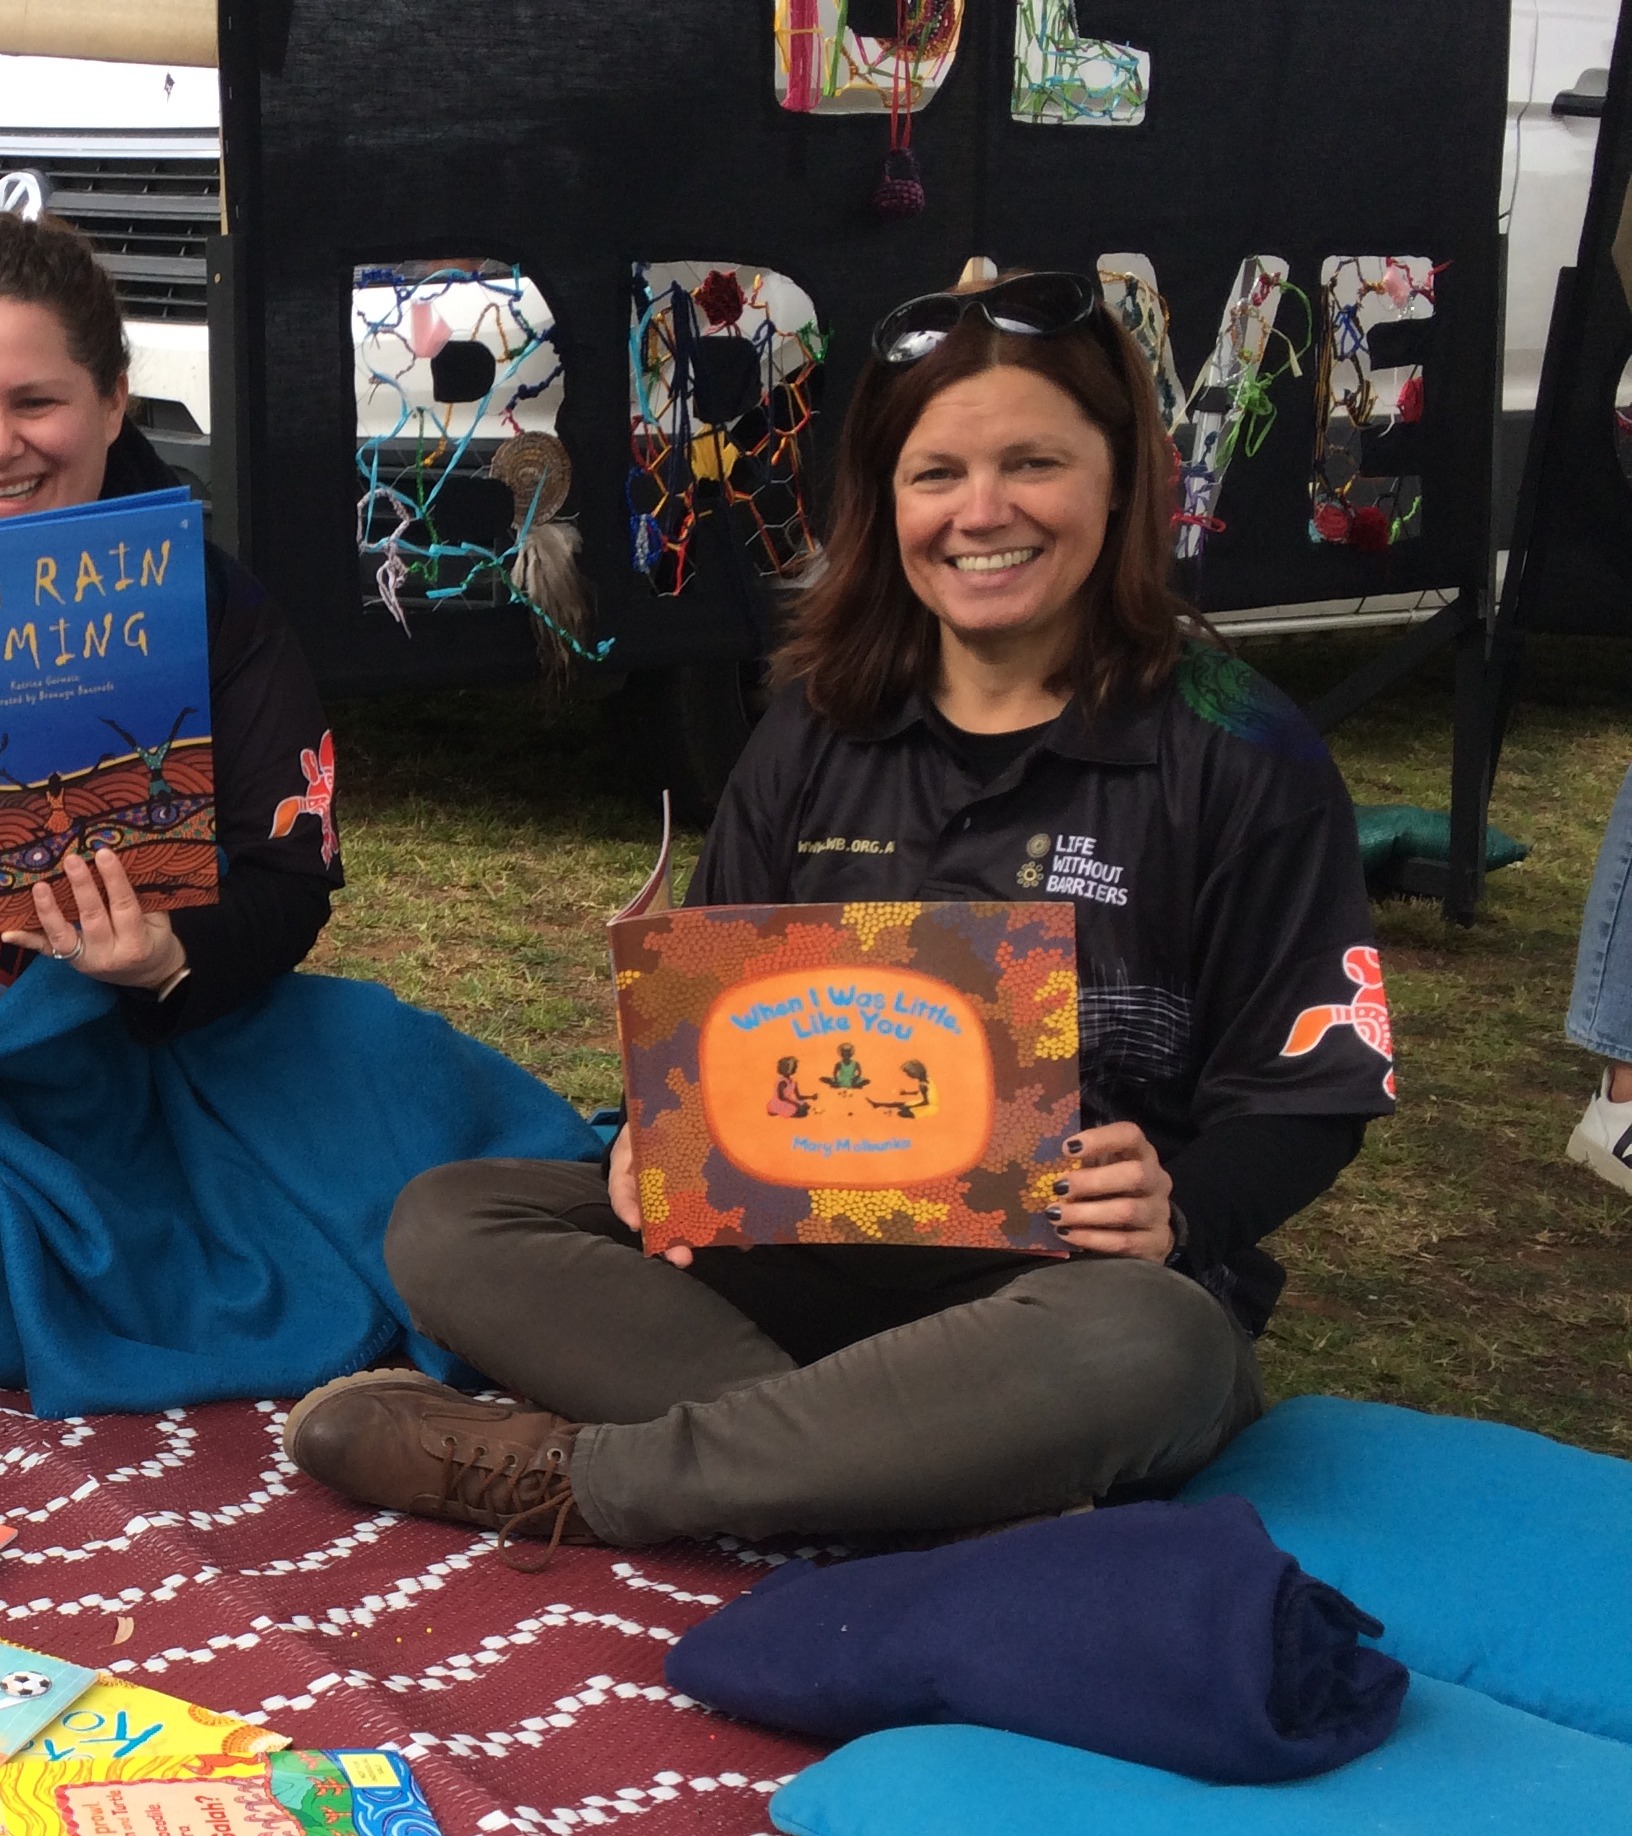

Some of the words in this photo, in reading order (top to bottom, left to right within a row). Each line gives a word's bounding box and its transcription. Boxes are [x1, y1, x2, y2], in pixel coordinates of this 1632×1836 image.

[351, 253, 1438, 605] BRVE
[34, 539, 172, 606] RAIN
[25, 693, 37, 705] by
[1054, 834, 1097, 856] LIFE
[1051, 855, 1125, 884] WITHOUT
[1045, 874, 1129, 906] BARRIERS
[731, 997, 804, 1031] When
[809, 987, 820, 1009] I
[827, 984, 886, 1011] Was
[893, 990, 963, 1035] Little,
[792, 1011, 851, 1039] Like
[859, 1008, 913, 1040] You
[792, 1135, 832, 1158] Mary
